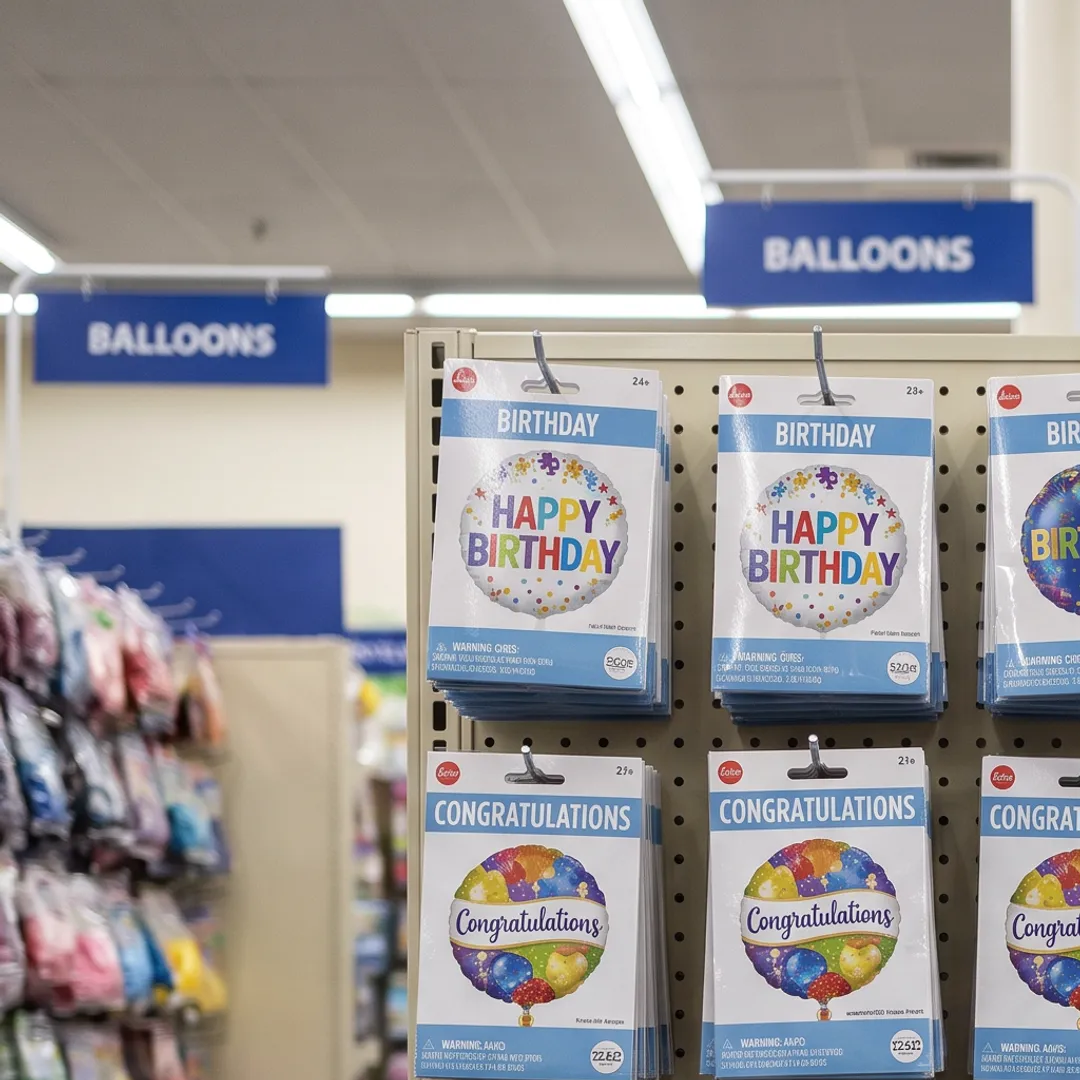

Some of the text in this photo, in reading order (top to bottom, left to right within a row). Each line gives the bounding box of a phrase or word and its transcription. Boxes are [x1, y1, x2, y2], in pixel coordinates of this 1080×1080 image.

[763, 235, 975, 272] BALLOONS
[87, 321, 276, 358] BALLOONS
[498, 409, 599, 437] BIRTHDAY
[776, 422, 876, 448] BIRTHDAY
[493, 495, 601, 533] HAPPY
[771, 510, 879, 546] HAPPY
[468, 532, 620, 575] BIRTHDAY
[749, 549, 900, 586] BIRTHDAY
[434, 800, 631, 831] CONGRATULATIONS
[720, 795, 916, 824] CONGRATULATIONS
[456, 906, 603, 942] Congratulations
[747, 900, 894, 940] Congratulations
